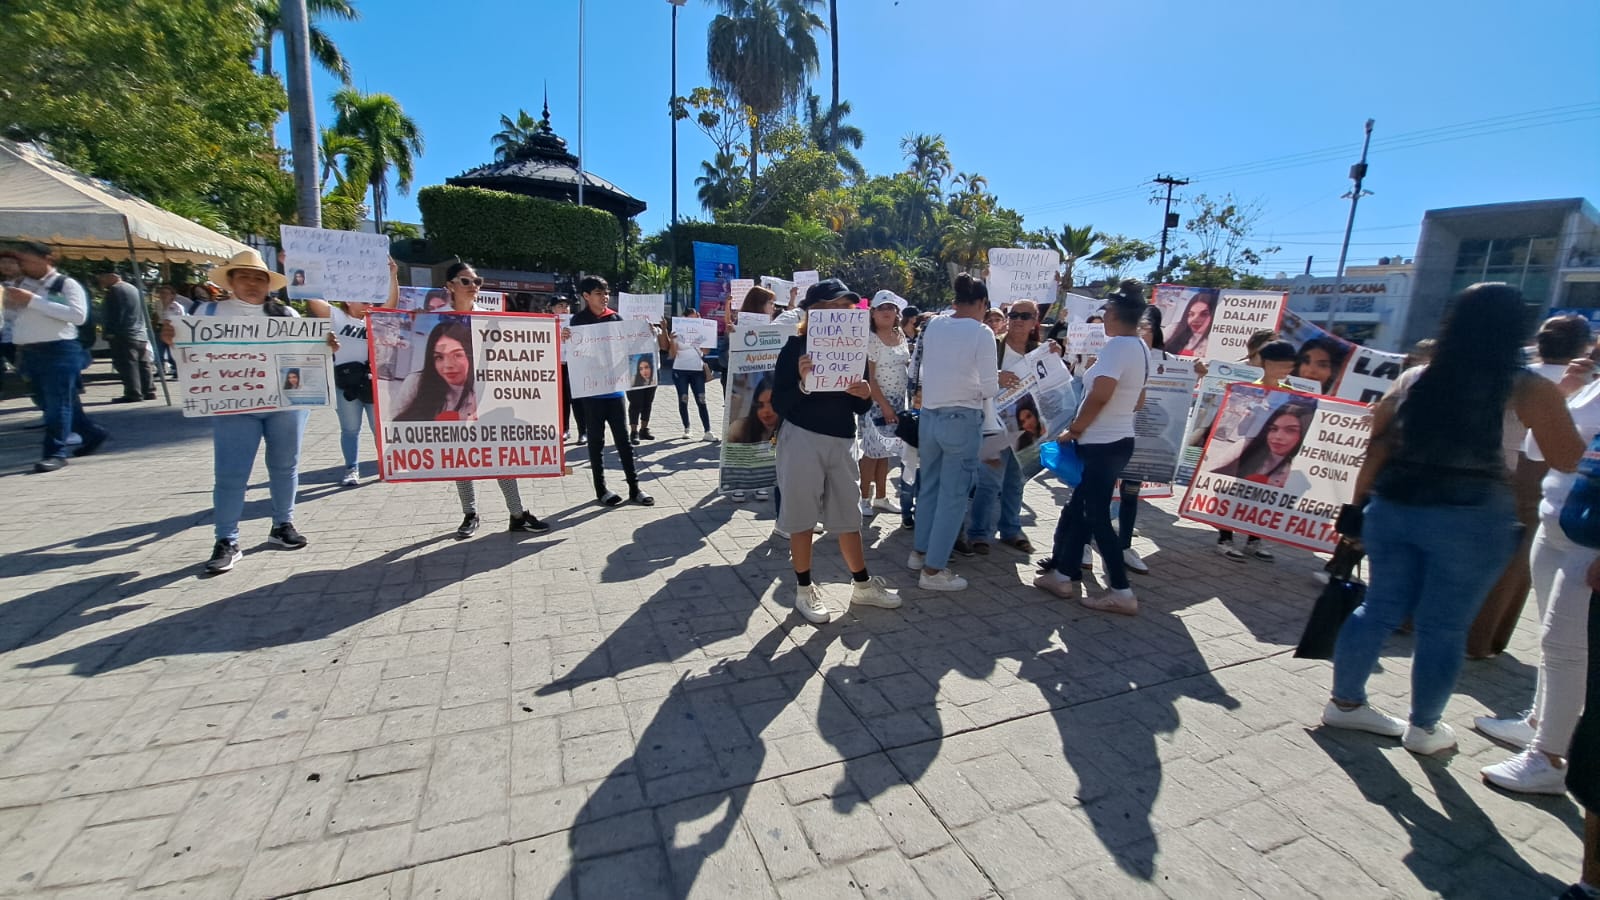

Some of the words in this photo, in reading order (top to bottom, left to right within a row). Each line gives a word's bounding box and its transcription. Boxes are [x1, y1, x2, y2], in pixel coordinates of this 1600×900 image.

[1223, 297, 1277, 310] YOSHIMI
[810, 311, 823, 323] SI
[1223, 310, 1269, 322] DALAIF
[182, 319, 259, 343] YOSHIMI
[266, 318, 331, 338] DALAIF
[478, 329, 551, 344] YOSHIMI
[809, 325, 842, 337] CUIDA
[852, 326, 867, 337] EL
[179, 347, 199, 363] Te
[205, 352, 267, 363] queremos
[485, 348, 545, 362] DALAIF
[190, 368, 209, 379] de
[829, 362, 850, 372] QUE
[476, 367, 556, 382] HERNÁNDEZ
[189, 384, 212, 394] en
[814, 375, 829, 389] TE
[493, 387, 542, 400] OSUNA
[384, 426, 401, 444] LA
[405, 425, 477, 444] QUEREMOS
[480, 425, 497, 442] DE
[501, 424, 556, 441] REGRESO
[386, 448, 434, 476] ¡NOS
[441, 447, 493, 469] HACE
[499, 446, 557, 467] FALTA!
[1309, 465, 1349, 482] OSUNA
[1195, 475, 1211, 490] LA
[1213, 479, 1279, 505] QUEREMOS
[1278, 493, 1298, 510] DE
[1185, 493, 1231, 516] ¡NOS
[1231, 502, 1284, 529] HACE
